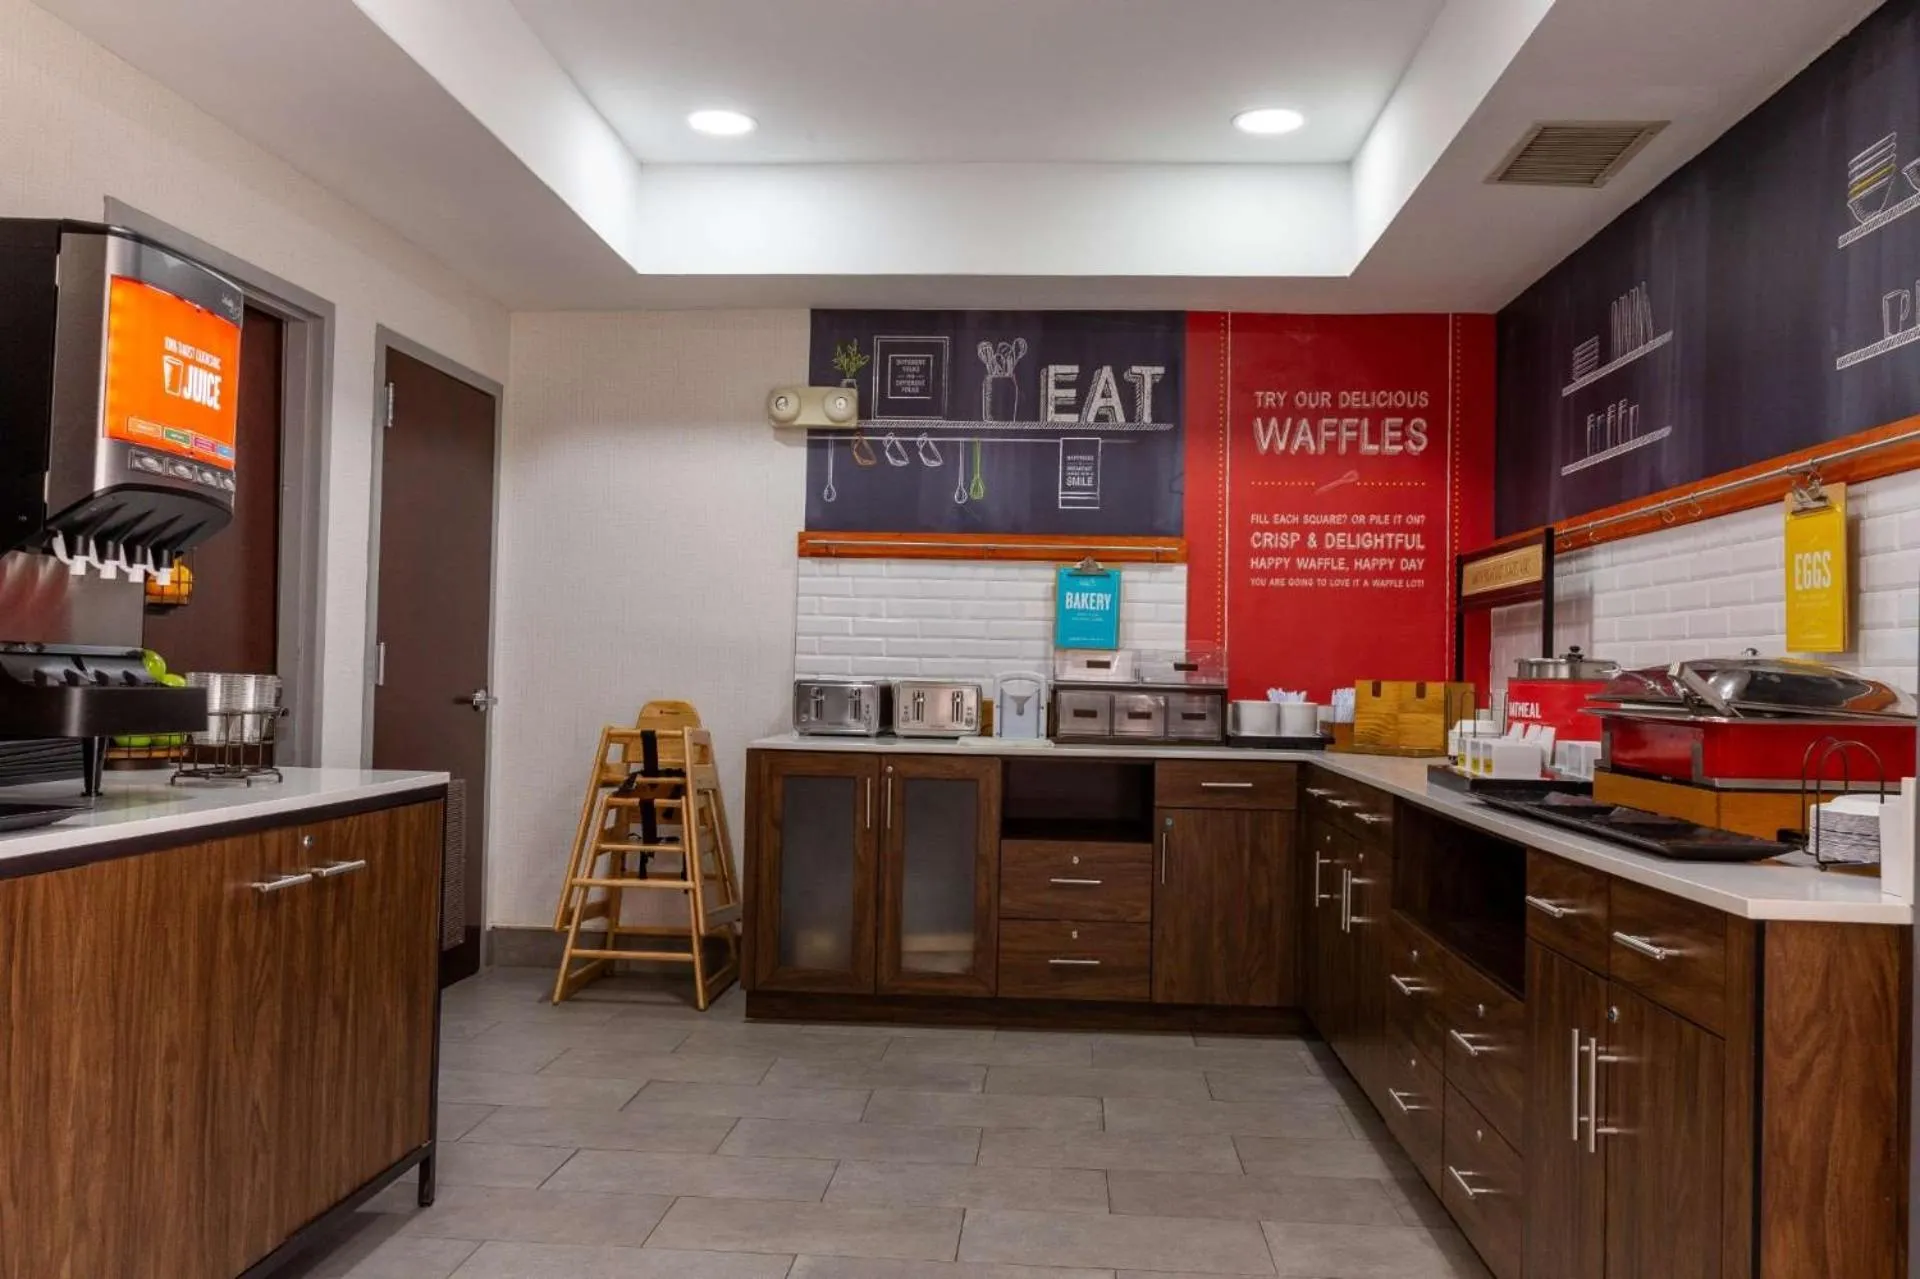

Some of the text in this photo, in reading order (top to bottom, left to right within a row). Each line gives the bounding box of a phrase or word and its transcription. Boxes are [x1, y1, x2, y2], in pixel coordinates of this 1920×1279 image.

[183, 364, 222, 411] JUICE
[1040, 364, 1165, 423] EAT
[1254, 391, 1429, 408] TRY OUR DELICIOUS
[1253, 417, 1429, 455] WAFFLES
[1066, 476, 1093, 487] SMILE
[1250, 513, 1426, 526] FILL EACH SQUARE? OR PILE IT ON?
[1250, 531, 1426, 551] CRISP & DELIGHTFUL
[1250, 556, 1425, 571] HAPPY WAFFLE, HAPPY DAY
[1794, 550, 1832, 591] EGGS
[1250, 578, 1267, 587] YOU
[1269, 578, 1286, 587] ARE
[1288, 578, 1314, 587] GOING
[1316, 578, 1327, 587] TO
[1329, 578, 1351, 588] LOVE
[1352, 578, 1360, 588] IT
[1362, 578, 1370, 588] A
[1065, 591, 1112, 611] BAKERY
